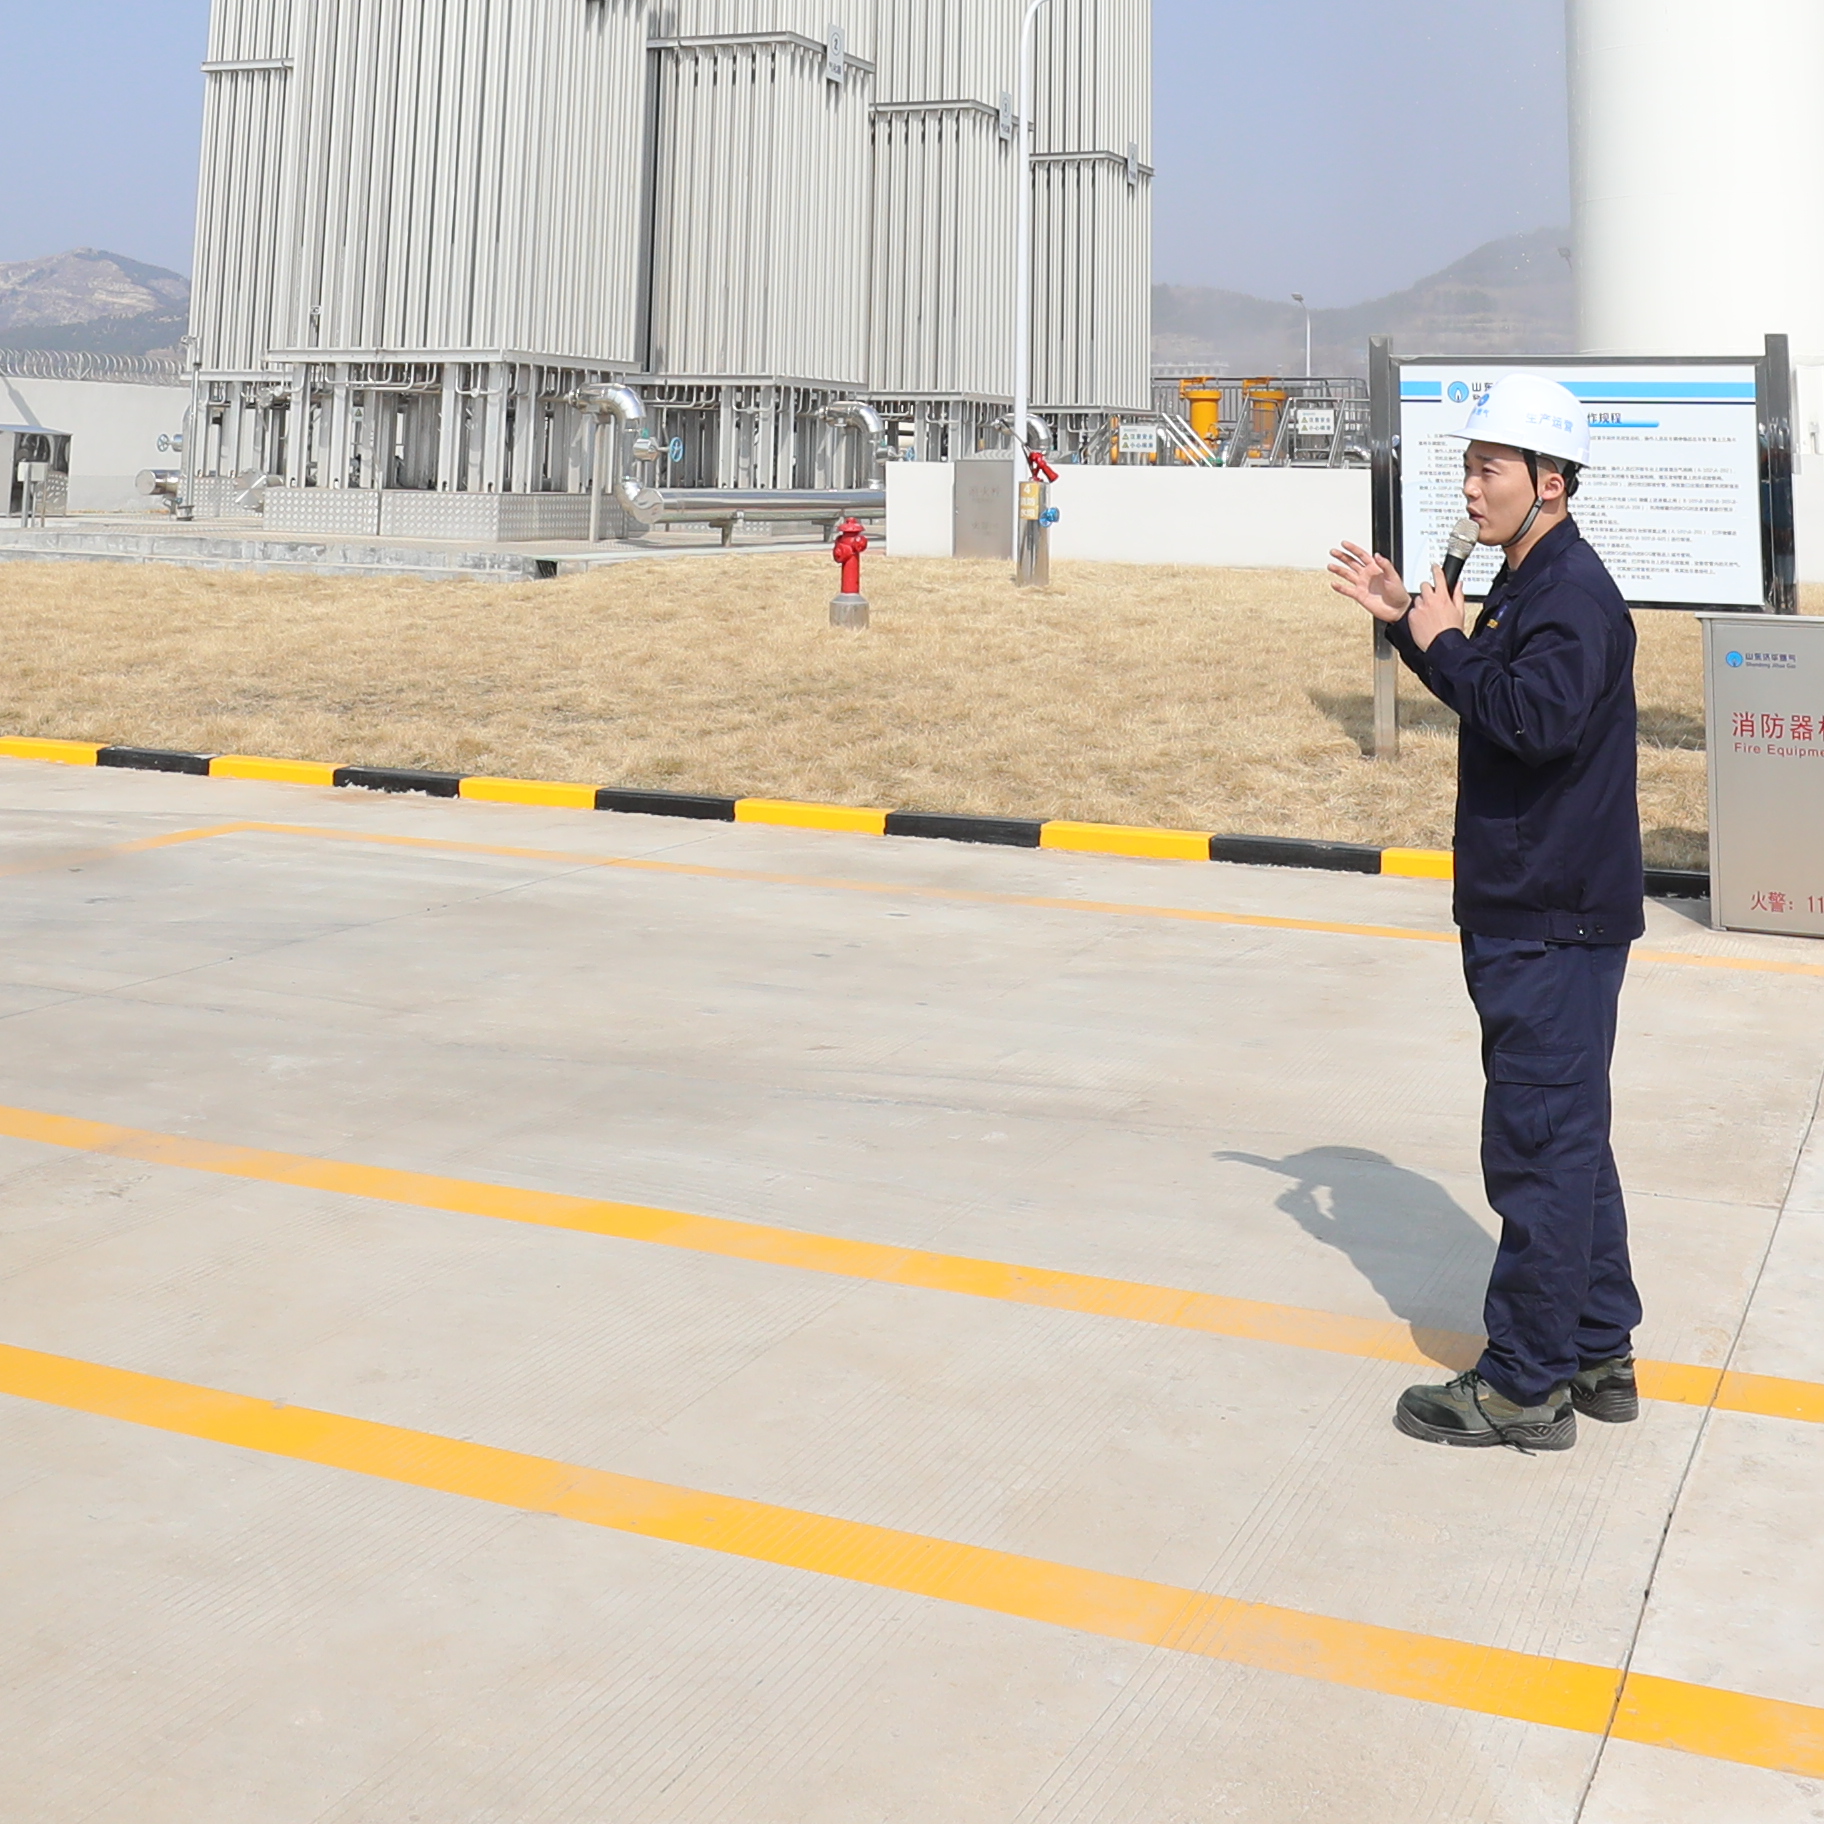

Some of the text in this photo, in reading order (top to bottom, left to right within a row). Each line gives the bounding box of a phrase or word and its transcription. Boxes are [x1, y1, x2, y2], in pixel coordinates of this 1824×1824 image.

[1525, 412, 1575, 433] 生产运营
[1734, 742, 1761, 754] Fire
